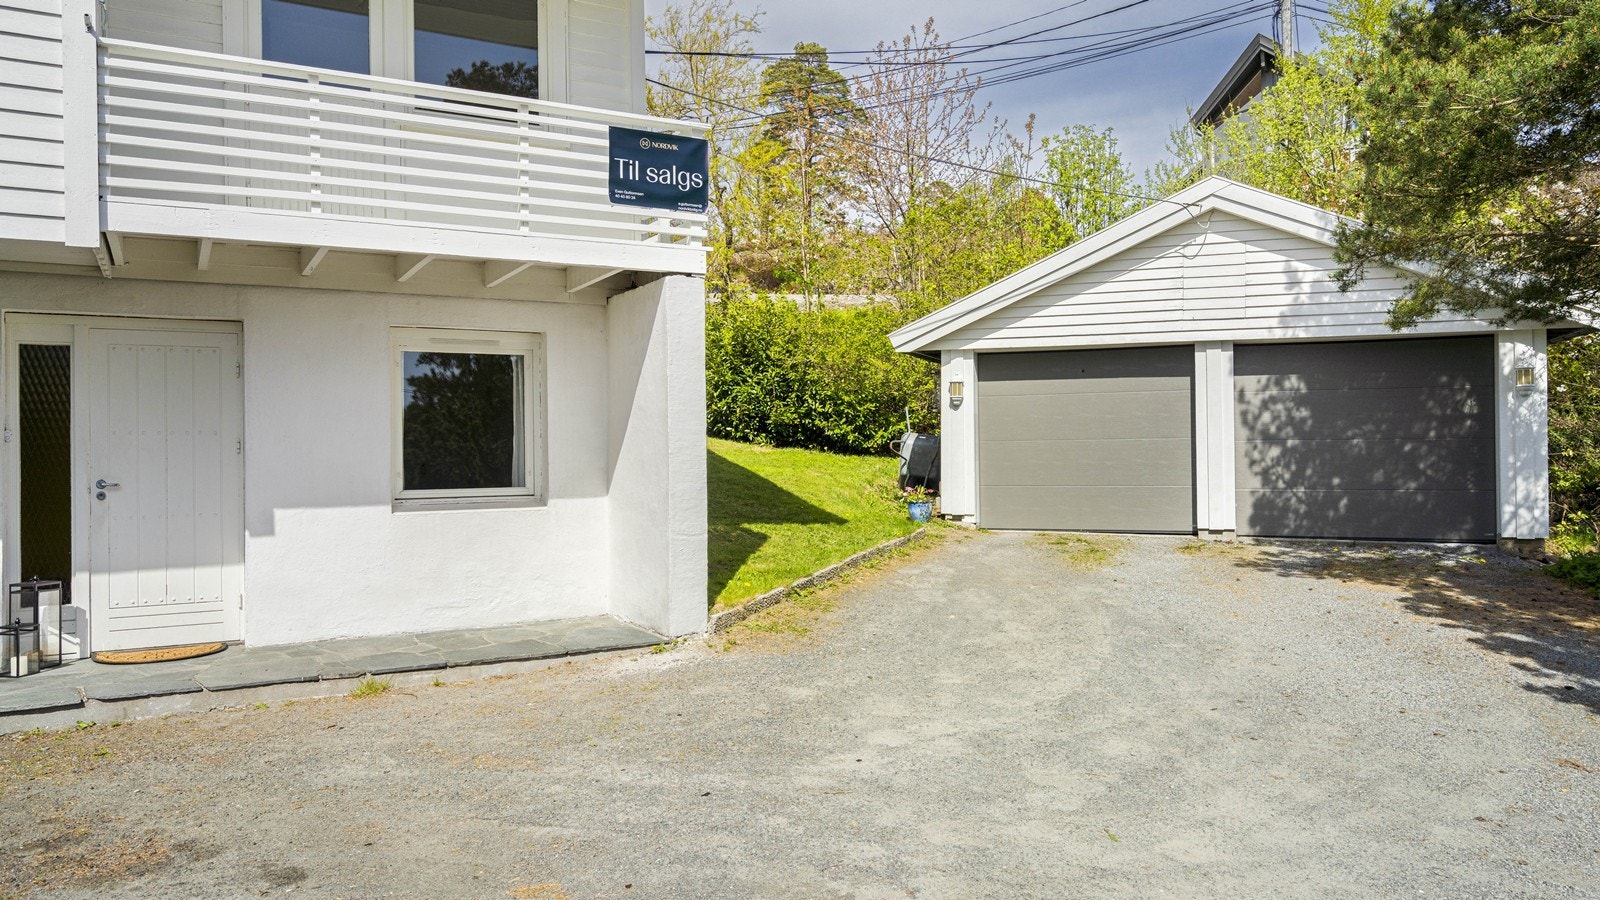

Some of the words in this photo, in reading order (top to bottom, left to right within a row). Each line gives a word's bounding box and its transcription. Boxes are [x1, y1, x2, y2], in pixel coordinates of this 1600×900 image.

[652, 141, 679, 151] NORDVIK
[614, 157, 639, 181] Til
[646, 165, 703, 192] salgs
